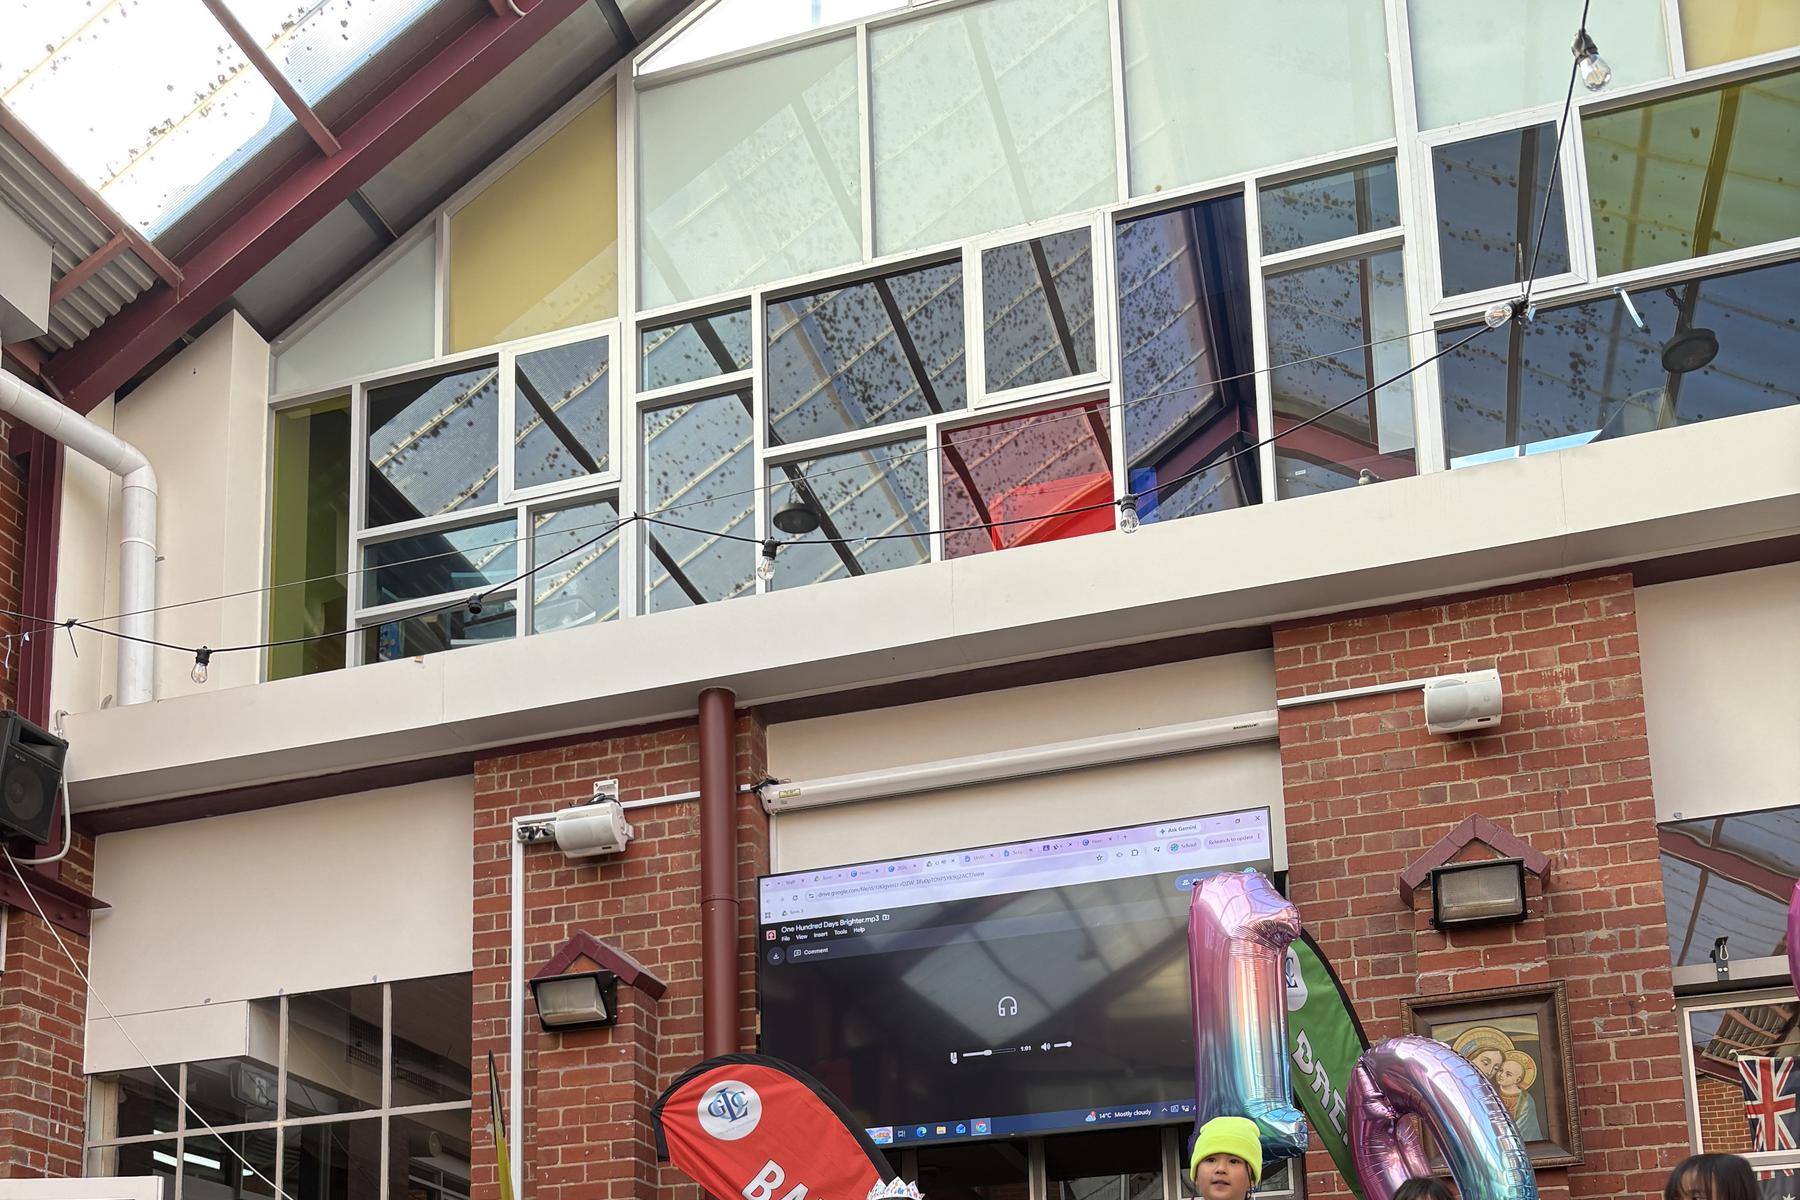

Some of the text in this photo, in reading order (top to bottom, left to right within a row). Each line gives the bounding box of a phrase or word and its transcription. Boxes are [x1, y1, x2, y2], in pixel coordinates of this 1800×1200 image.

[1178, 824, 1197, 832] Gemini
[781, 914, 880, 934] One Hundred Days Brighter.mp3
[795, 933, 808, 941] View
[834, 928, 848, 936] Tools
[853, 926, 866, 935] Help
[803, 947, 829, 956] Comment
[1291, 1028, 1350, 1148] BRE
[1114, 1110, 1133, 1119] Mostly
[1133, 1108, 1152, 1117] cloudy
